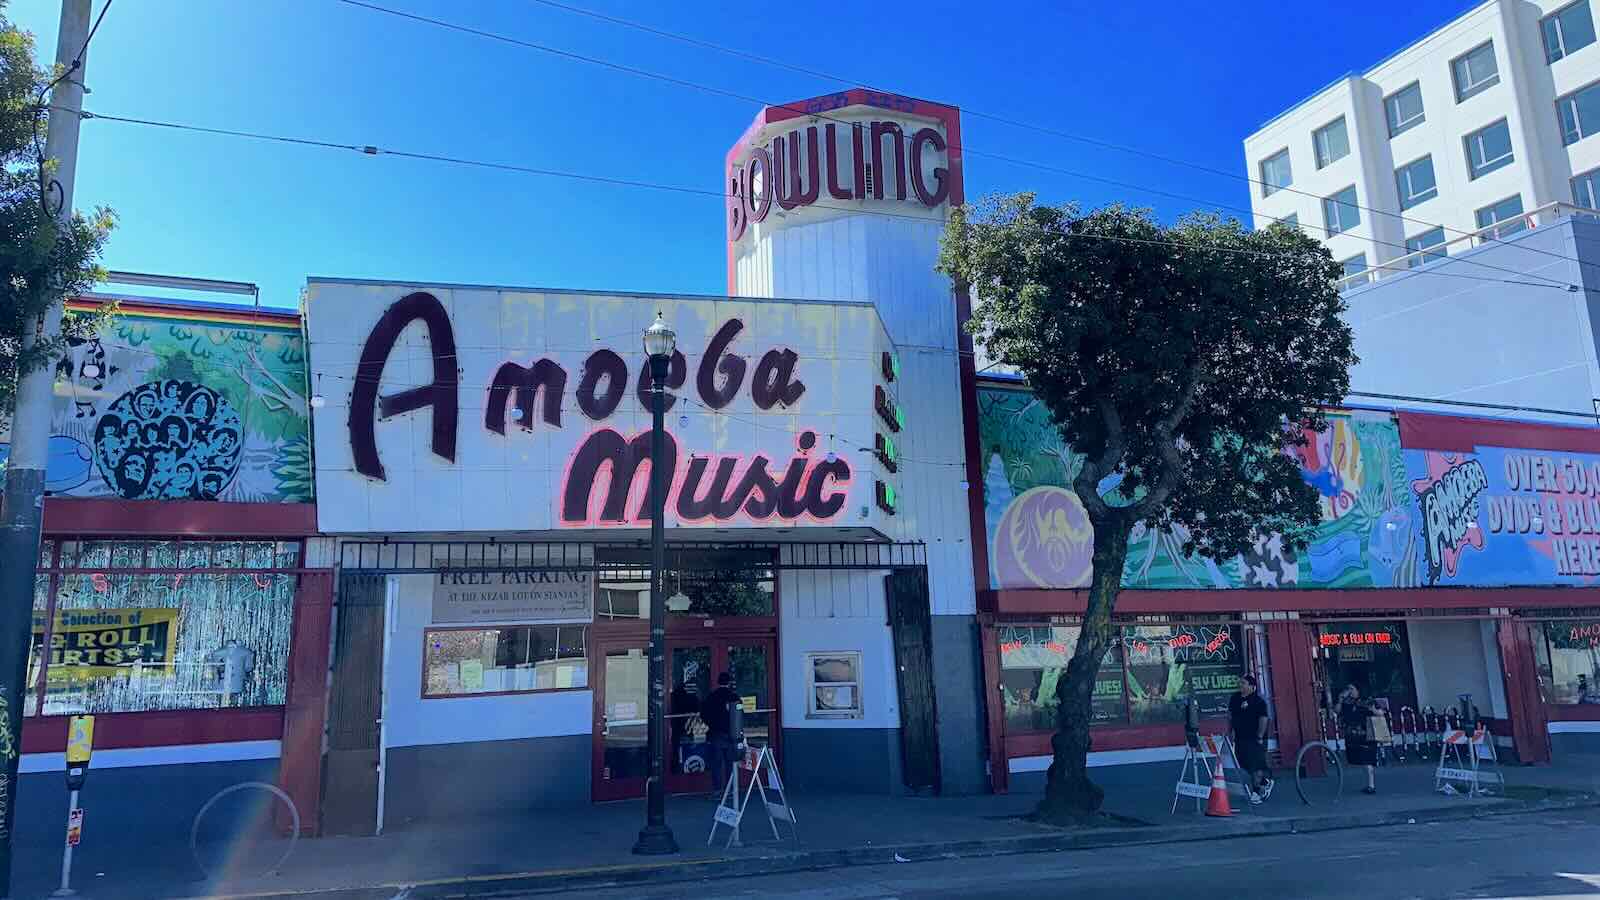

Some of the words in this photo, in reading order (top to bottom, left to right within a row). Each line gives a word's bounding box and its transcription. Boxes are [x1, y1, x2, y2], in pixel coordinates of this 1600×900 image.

[729, 121, 950, 241] BOWLING
[348, 292, 806, 482] Amoeba
[563, 429, 851, 522] Music
[1504, 454, 1560, 494] OVER
[440, 567, 493, 585] FREE
[501, 567, 586, 585] PARKING
[78, 627, 155, 647] ROLL
[50, 648, 124, 665] IRTS
[1192, 676, 1210, 689] SLY
